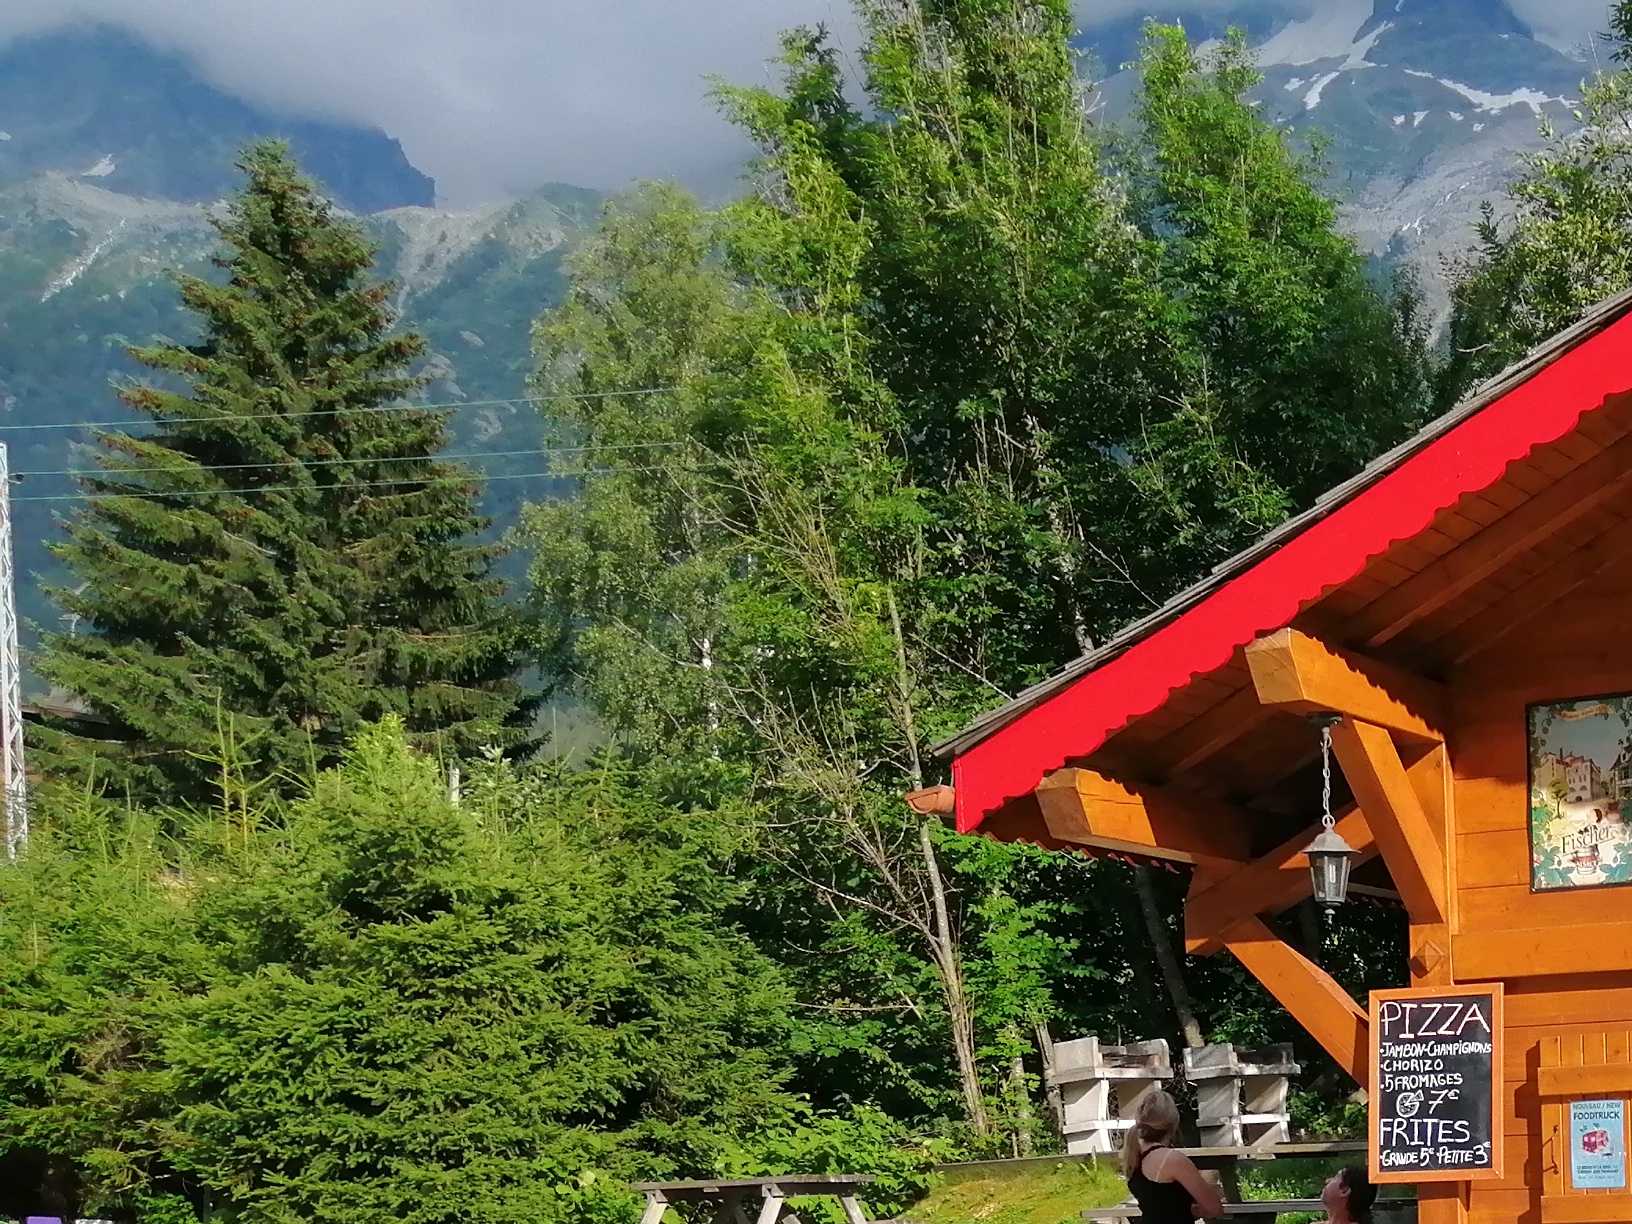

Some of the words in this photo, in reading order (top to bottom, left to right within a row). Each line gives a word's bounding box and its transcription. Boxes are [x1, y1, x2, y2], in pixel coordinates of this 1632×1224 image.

[1561, 825, 1613, 854] Fischer
[1379, 1001, 1491, 1039] PIZZA
[1383, 1059, 1444, 1073] CHORIZO
[1573, 1111, 1620, 1120] FOODTRUCK
[1380, 1117, 1470, 1147] FRITES
[1438, 1146, 1474, 1165] PETITE
